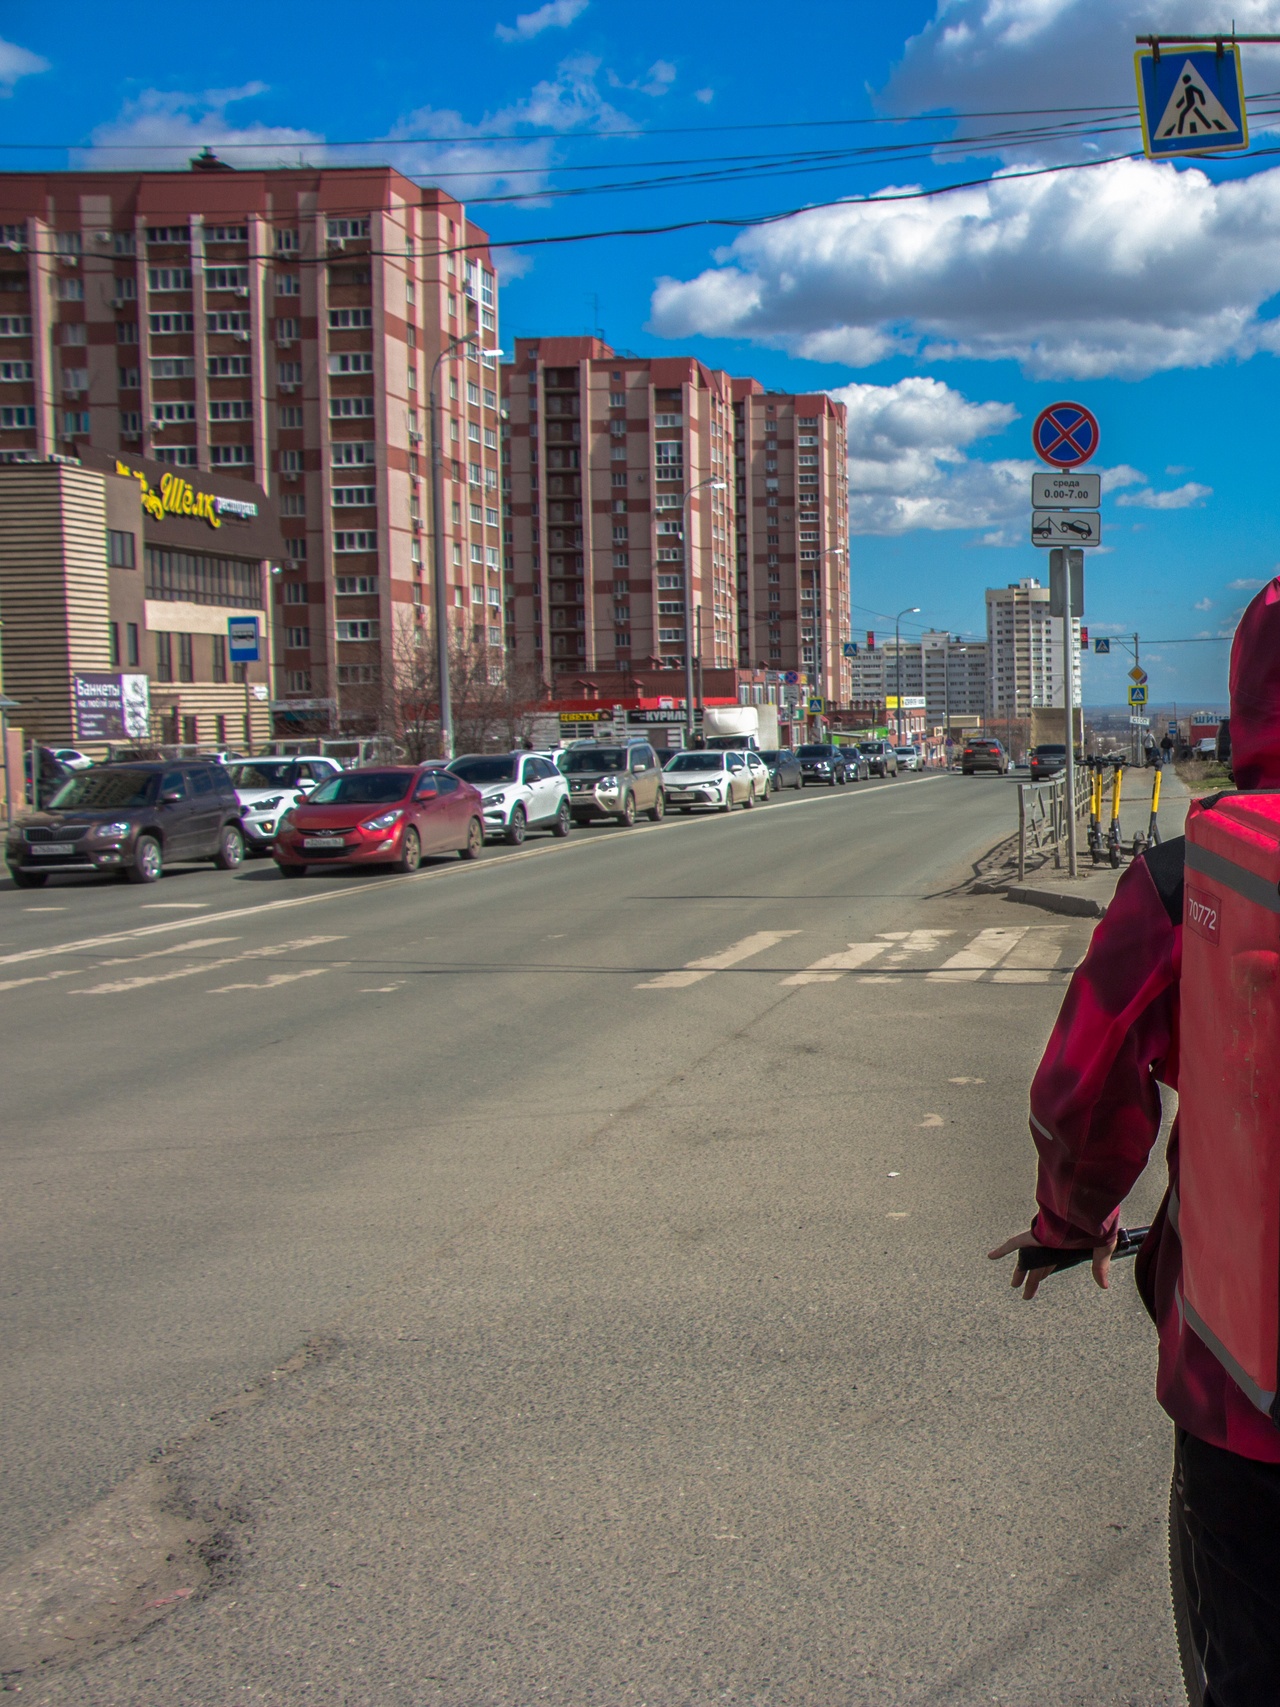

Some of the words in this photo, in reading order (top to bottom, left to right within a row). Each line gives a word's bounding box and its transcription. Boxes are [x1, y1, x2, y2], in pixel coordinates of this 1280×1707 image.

[1053, 480, 1080, 488] среда
[1044, 489, 1089, 499] 0.00-7.00
[217, 497, 257, 517] ресторан
[77, 679, 120, 696] Банкеты
[560, 713, 599, 722] ЦВЕТЫ
[1189, 898, 1217, 930] 70772
